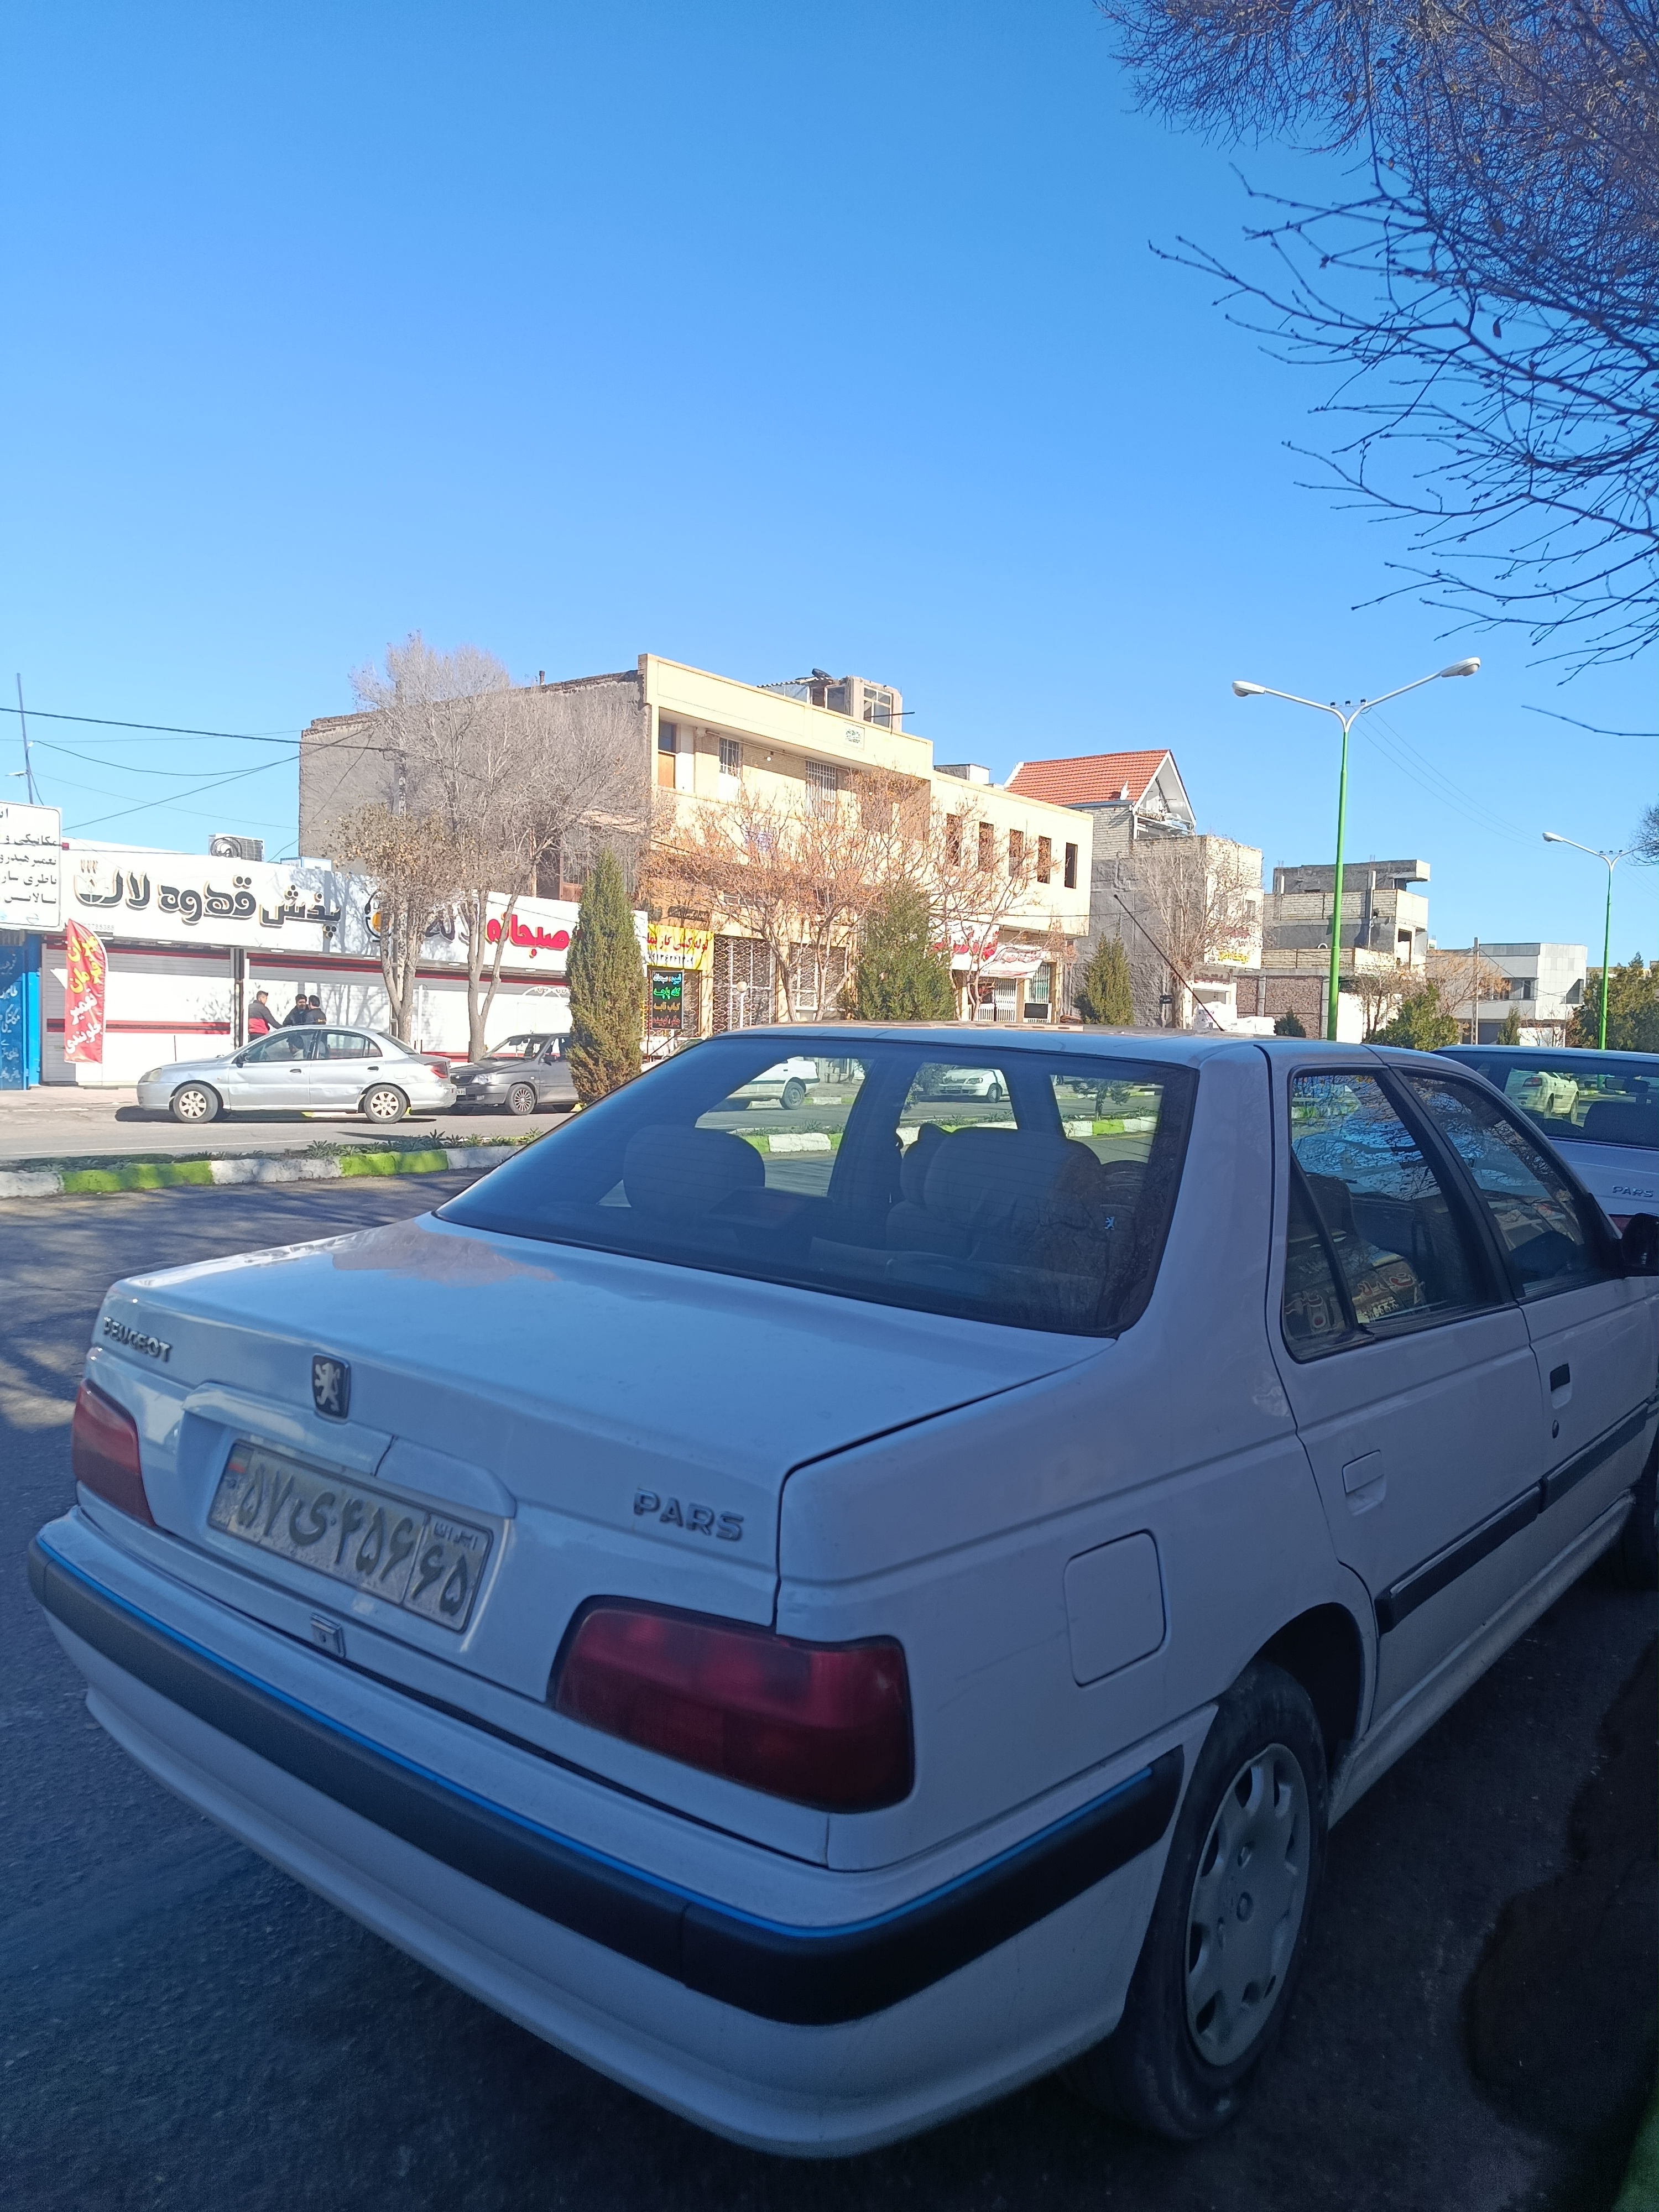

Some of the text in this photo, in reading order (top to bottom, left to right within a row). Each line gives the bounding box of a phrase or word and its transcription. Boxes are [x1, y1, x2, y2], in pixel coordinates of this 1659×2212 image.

[30, 855, 57, 867] تعمیر
[4, 891, 57, 904] بالانس
[24, 873, 57, 887] باطری
[158, 874, 257, 926] قهوه
[260, 884, 342, 939] پخش
[70, 958, 103, 994] فرمان
[70, 988, 98, 1025] تعمیر
[65, 1022, 103, 1053] جلوبندی
[1612, 1185, 1654, 1198] PARS
[103, 1317, 173, 1362] PEUGEOT
[633, 1488, 744, 1542] PARS
